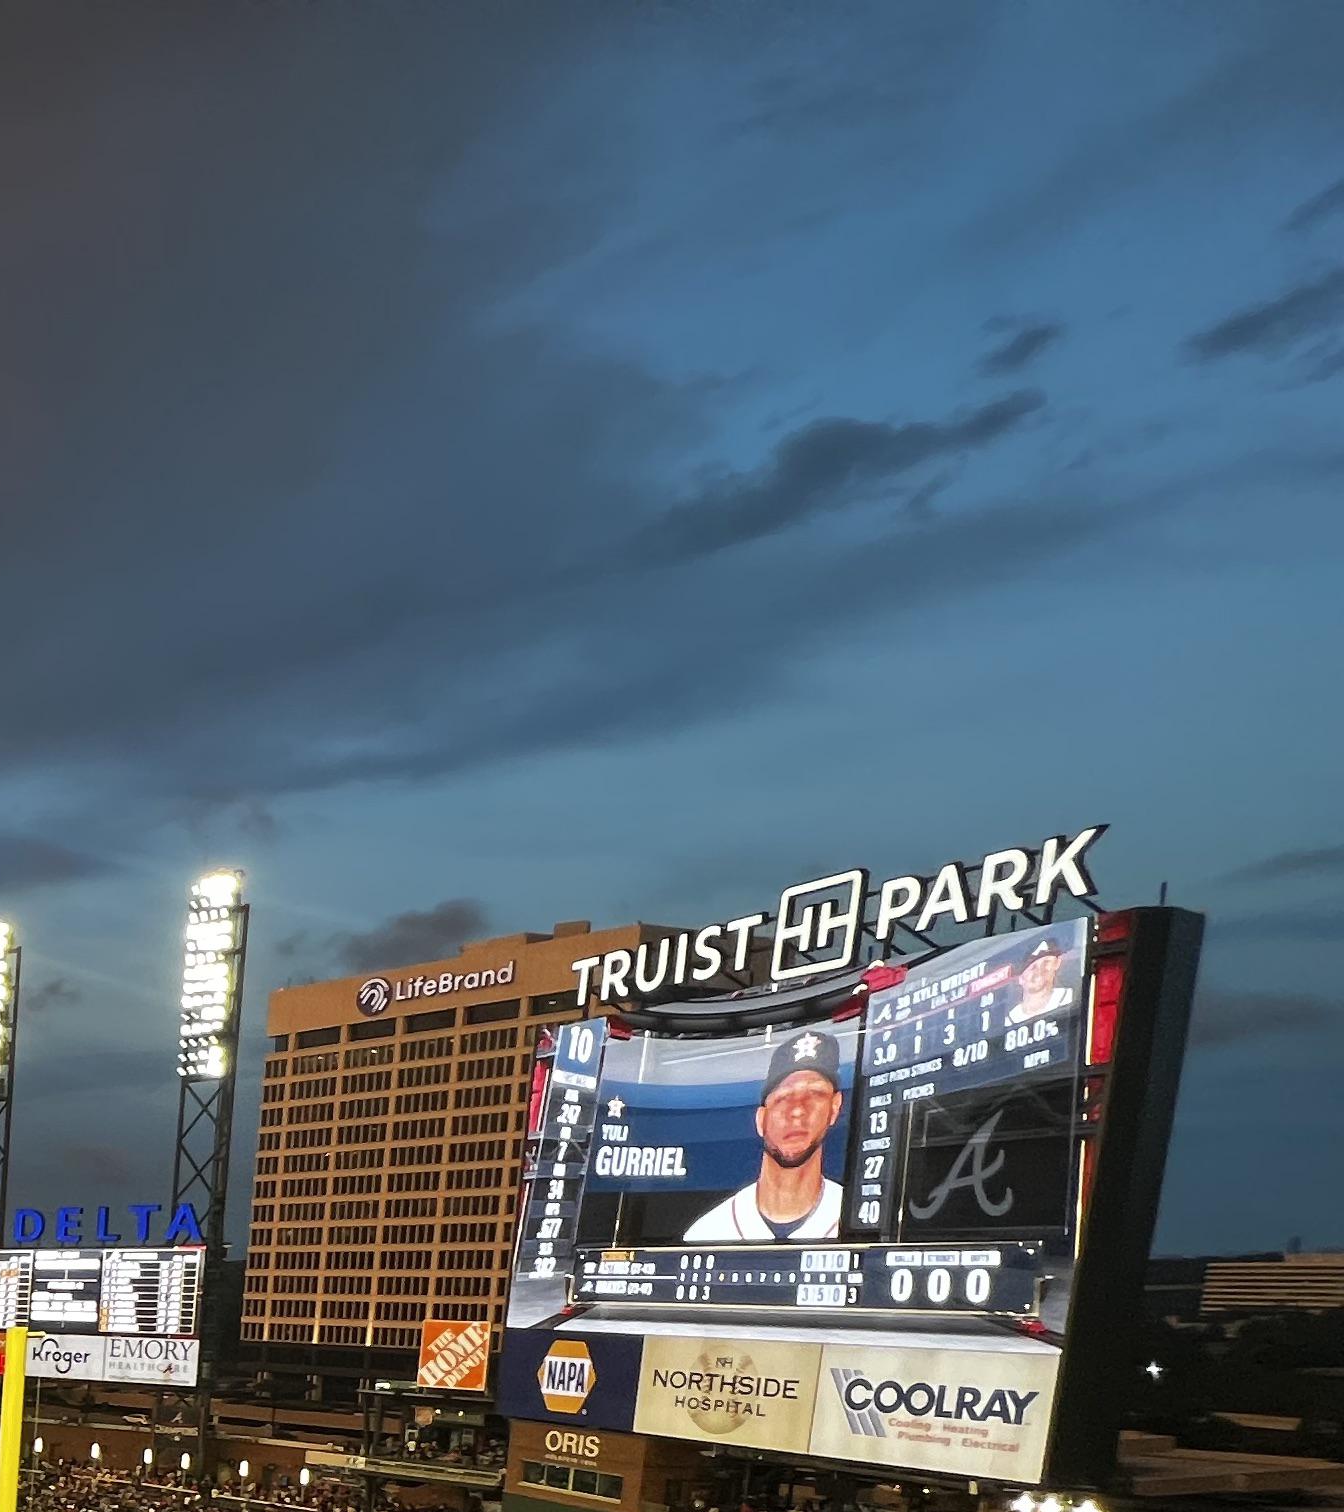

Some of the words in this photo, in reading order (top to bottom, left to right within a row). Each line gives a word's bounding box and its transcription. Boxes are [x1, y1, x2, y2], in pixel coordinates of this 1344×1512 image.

[572, 914, 763, 1006] TRUIST
[876, 826, 1104, 940] PARK
[395, 961, 515, 1001] LifeBrand
[940, 962, 987, 993] WRIGHT
[568, 1026, 594, 1064] 10
[874, 1044, 897, 1066] 3.0
[944, 1024, 956, 1045] 3
[981, 1010, 990, 1032] 1
[953, 1039, 988, 1067] 8/10
[1005, 1019, 1060, 1052] 80.0%
[602, 1124, 629, 1141] YULI
[869, 1110, 888, 1134] 13
[558, 1141, 568, 1161] 7
[595, 1145, 688, 1177] GURRIEL
[863, 1155, 885, 1180] 27
[14, 1203, 204, 1244] DELTA
[858, 1201, 881, 1224] 40
[890, 1268, 914, 1302] 0
[927, 1268, 952, 1303] 0
[965, 1269, 992, 1304] 0
[32, 1338, 91, 1374] Kroger
[109, 1338, 195, 1362] EMORY
[418, 1325, 489, 1386] HOME
[427, 1328, 456, 1353] THE
[546, 1360, 586, 1394] NAPA
[652, 1369, 801, 1400] NORTHSIDE
[674, 1395, 766, 1417] HOSPITAL
[845, 1377, 1041, 1426] COOLRAY
[888, 1417, 932, 1432] Cooling
[943, 1423, 990, 1439] Heating
[897, 1431, 951, 1446] Plumbing
[962, 1438, 1020, 1453] Electrical
[545, 1430, 601, 1458] ORIS
